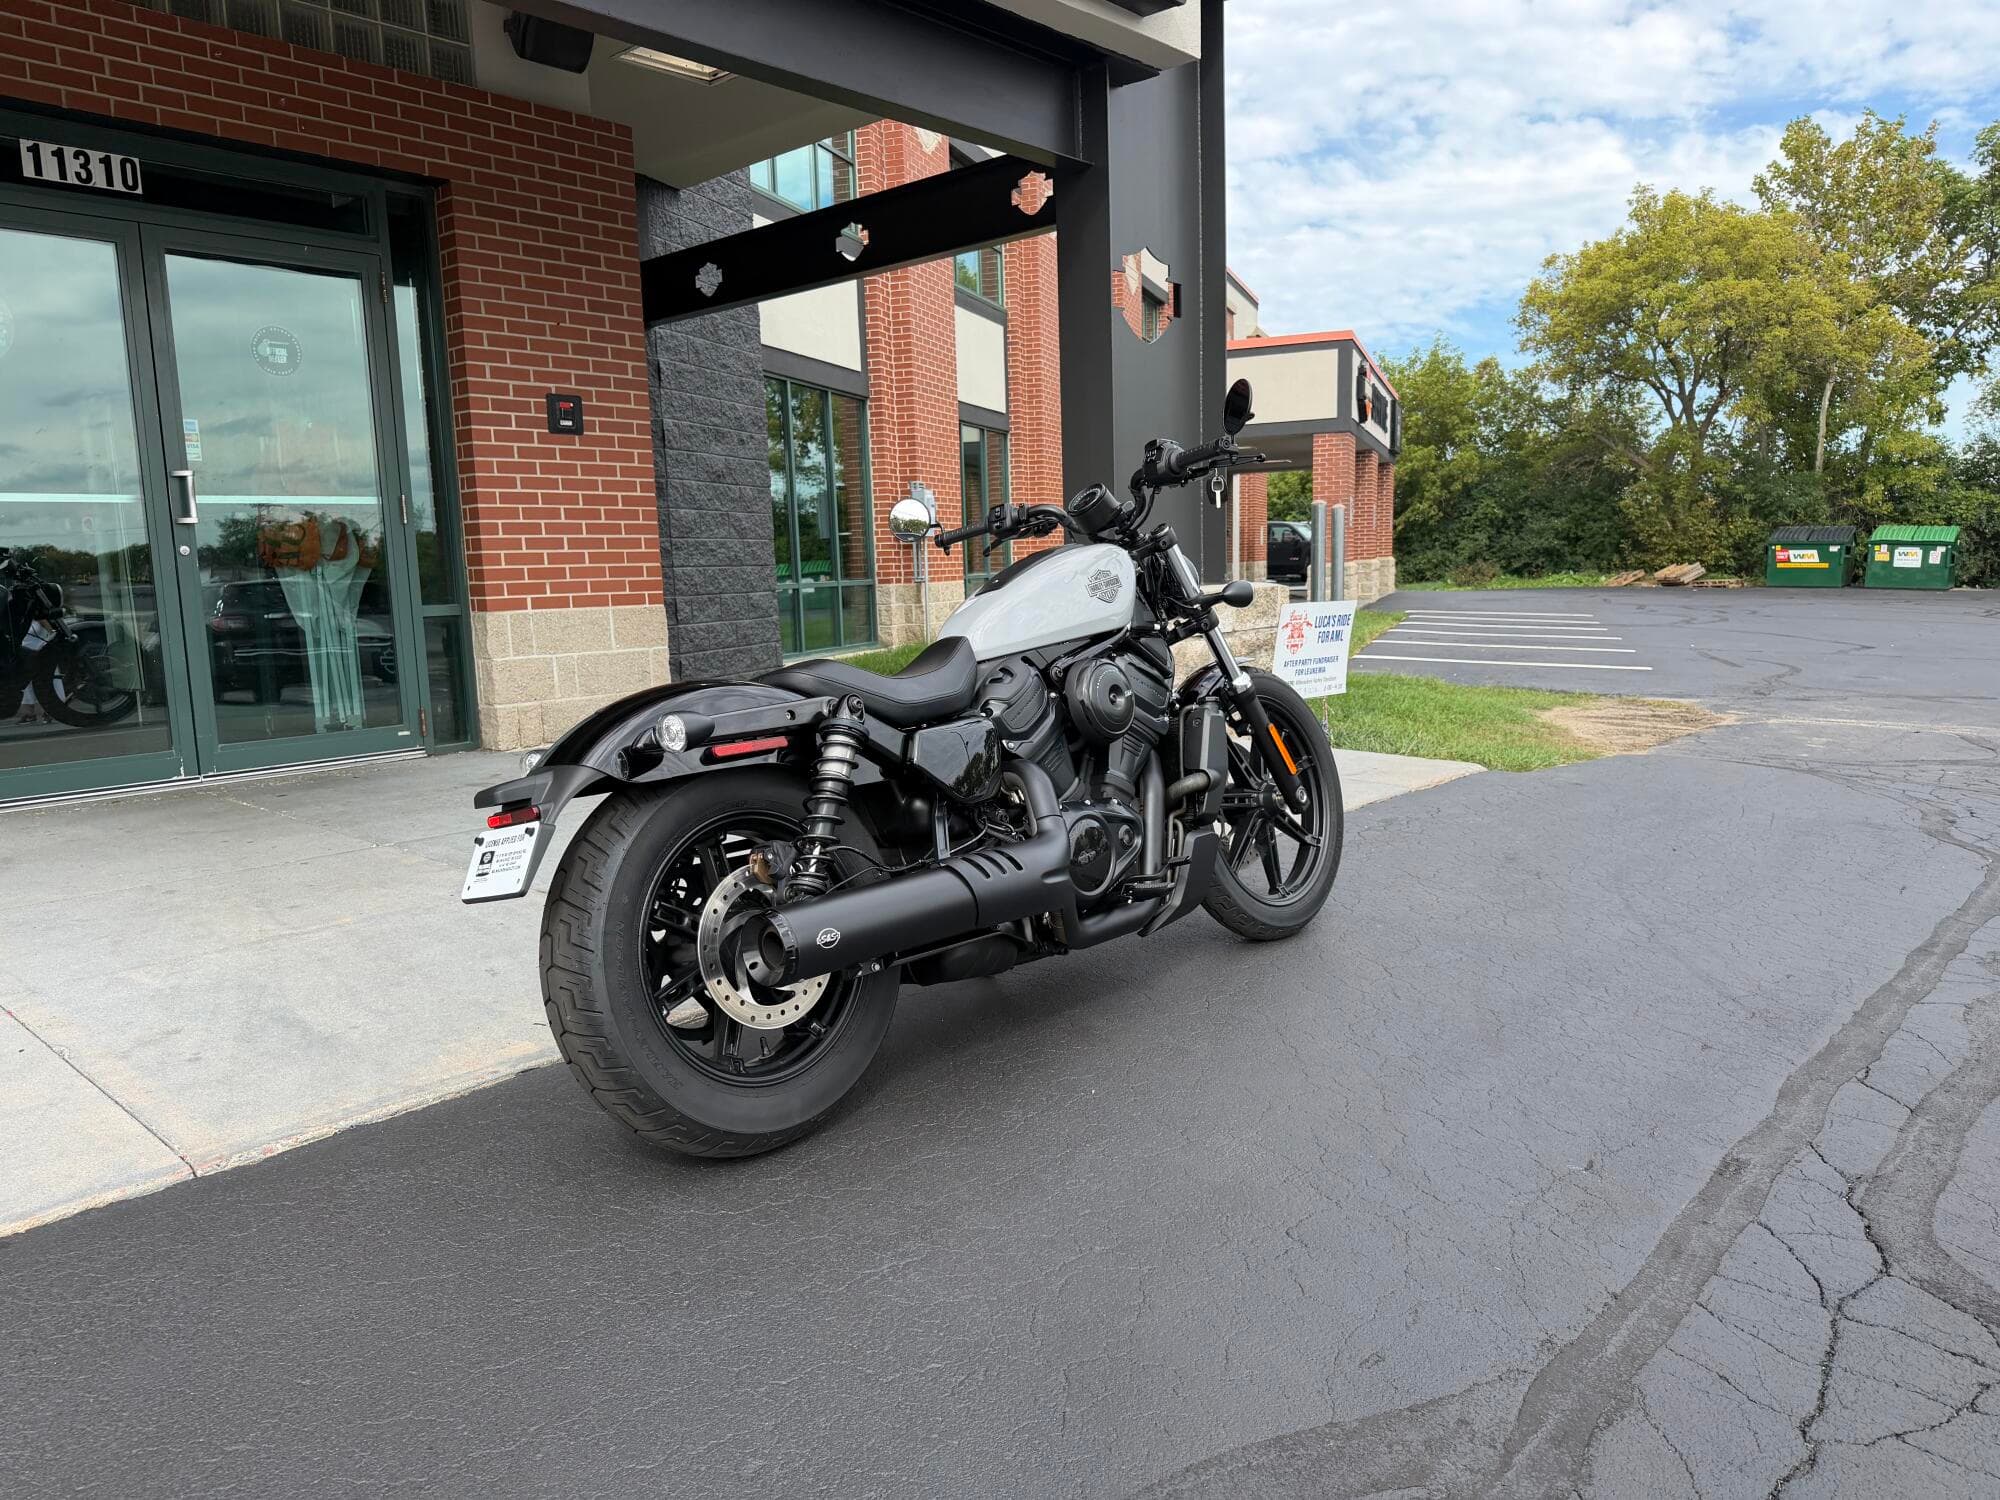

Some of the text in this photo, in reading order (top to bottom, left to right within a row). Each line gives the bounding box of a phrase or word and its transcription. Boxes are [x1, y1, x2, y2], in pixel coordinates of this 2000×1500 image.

[26, 142, 139, 191] 11310
[1314, 613, 1352, 629] LUCA'S RIDE
[1317, 630, 1344, 644] FOR AML
[1283, 655, 1339, 668] AFTER PARTY FUNDRAISER
[1295, 668, 1305, 677] FOR
